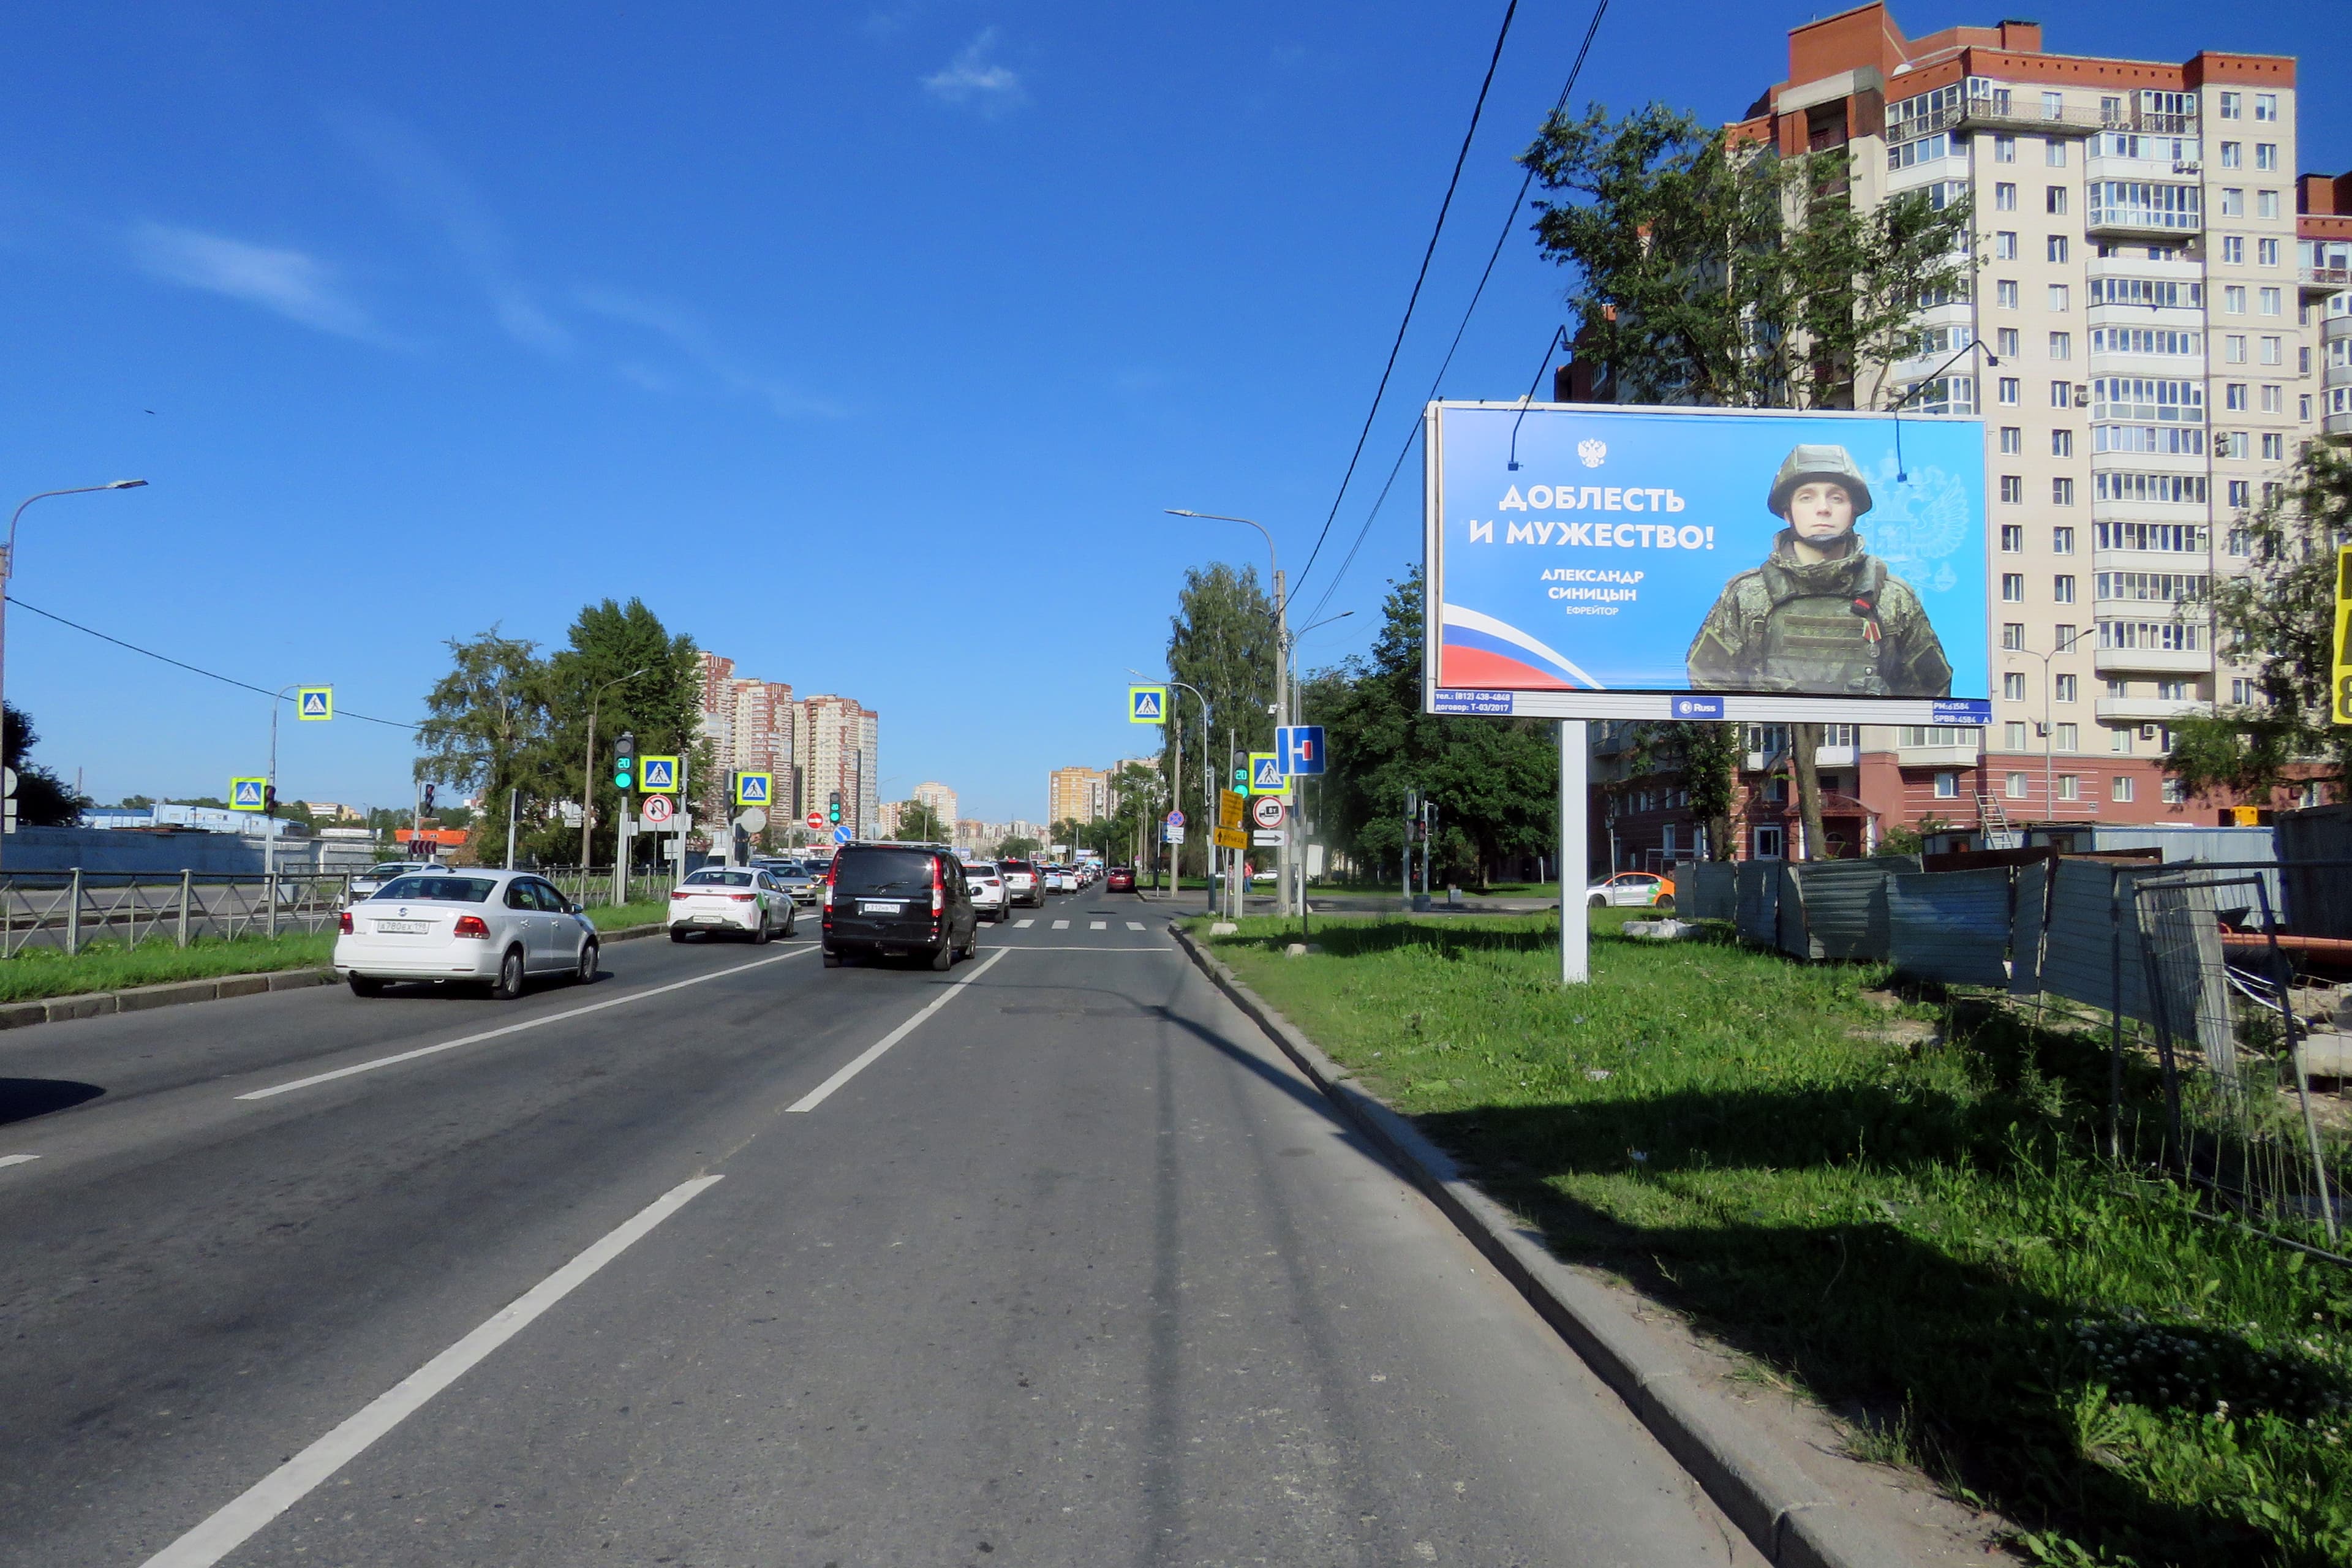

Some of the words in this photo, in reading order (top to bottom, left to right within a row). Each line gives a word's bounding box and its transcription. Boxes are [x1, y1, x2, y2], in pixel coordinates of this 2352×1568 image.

[1499, 484, 1685, 512] ДОБЛЕСТЬ
[1470, 519, 1493, 544] И
[1506, 521, 1714, 550] МУЖЕСТВО!
[1540, 568, 1645, 585] АЛЕКСАНДР
[1548, 587, 1637, 601] СИНИЦЫН
[1566, 603, 1619, 616] ЕФРЕЙТОР
[1455, 692, 1474, 701] (812)
[1471, 703, 1509, 712] Т-03/2017
[1694, 703, 1716, 712] Russ
[618, 758, 630, 768] 20
[1236, 770, 1247, 780] 20
